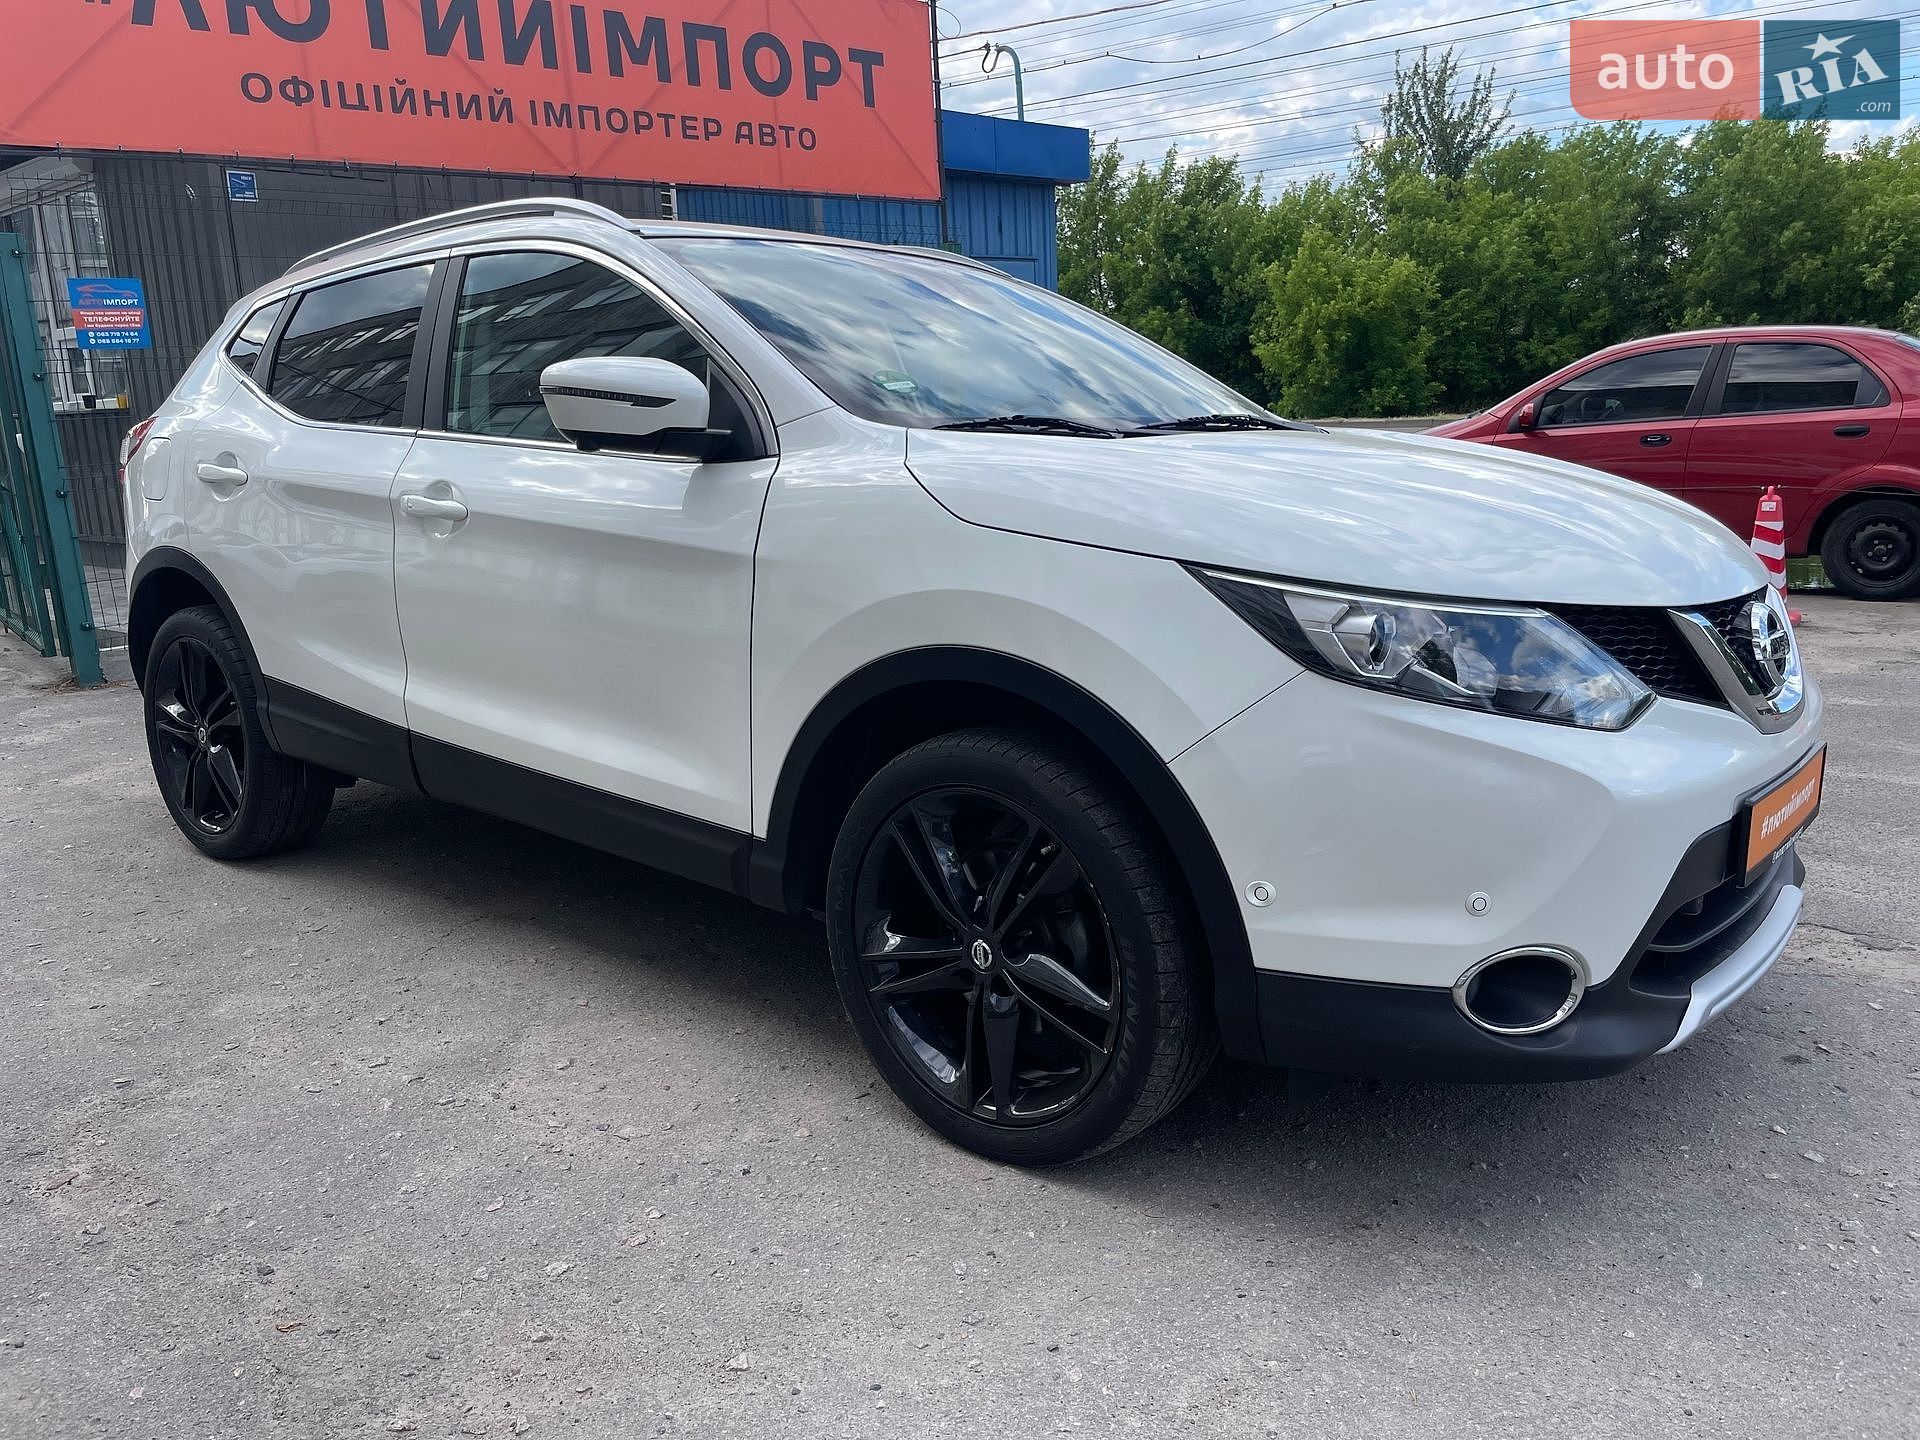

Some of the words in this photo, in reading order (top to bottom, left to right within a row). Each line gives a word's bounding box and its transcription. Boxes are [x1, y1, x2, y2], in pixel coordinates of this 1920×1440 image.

[240, 72, 515, 124] ОФІЦІЙНИЙ
[529, 99, 723, 142] ІМПОРТЕР
[734, 121, 817, 151] АВТО
